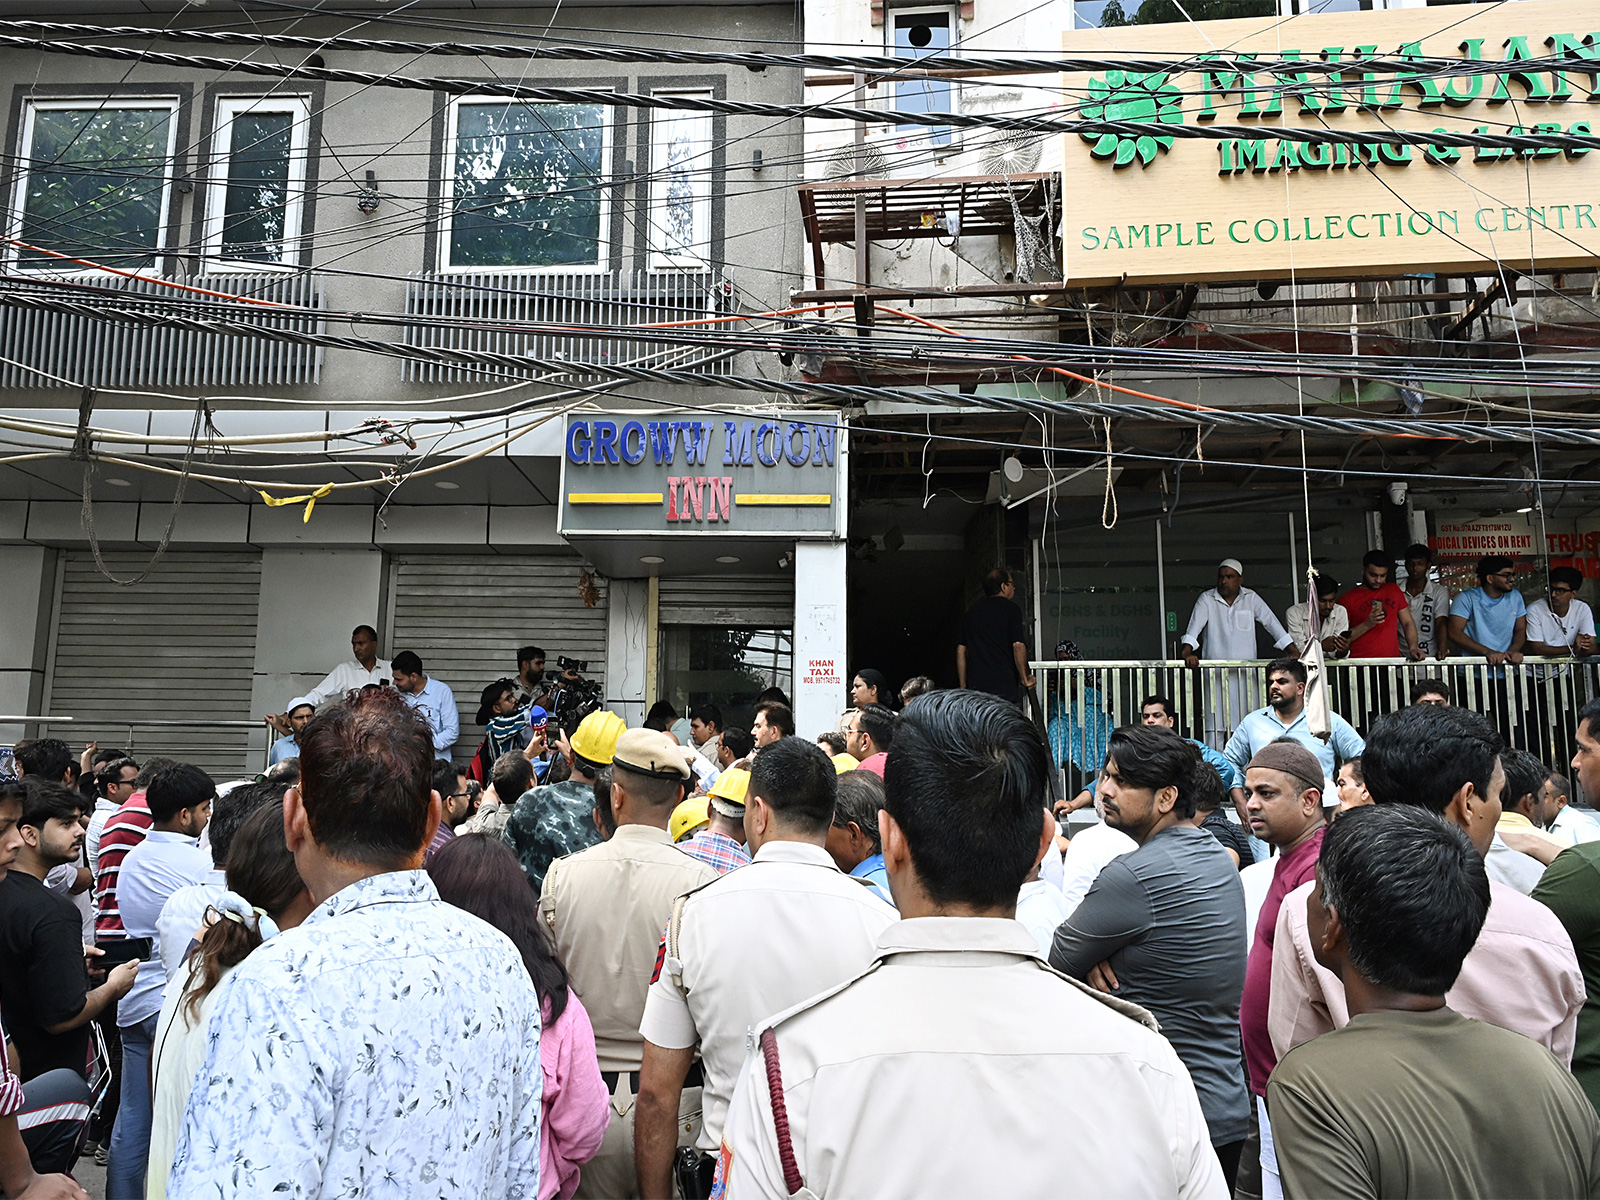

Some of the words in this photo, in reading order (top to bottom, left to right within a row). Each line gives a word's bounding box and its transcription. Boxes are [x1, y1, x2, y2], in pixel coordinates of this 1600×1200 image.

[1196, 32, 1600, 121] MAHAJAN
[1217, 129, 1413, 175] IMAGING
[1471, 121, 1593, 163] LABS
[1081, 221, 1215, 251] SAMPLE
[1228, 210, 1460, 244] COLLECTION
[1474, 203, 1600, 233] CENTR
[566, 421, 713, 465] GROWW
[722, 421, 837, 466] MOON
[666, 476, 733, 522] INN
[1462, 535, 1497, 549] DEVICES
[1499, 535, 1509, 548] ON
[1511, 535, 1531, 548] RENT
[1096, 605, 1107, 617] &
[1420, 595, 1433, 633] AERO
[1074, 625, 1130, 641] Facility
[1081, 646, 1139, 659] vailable
